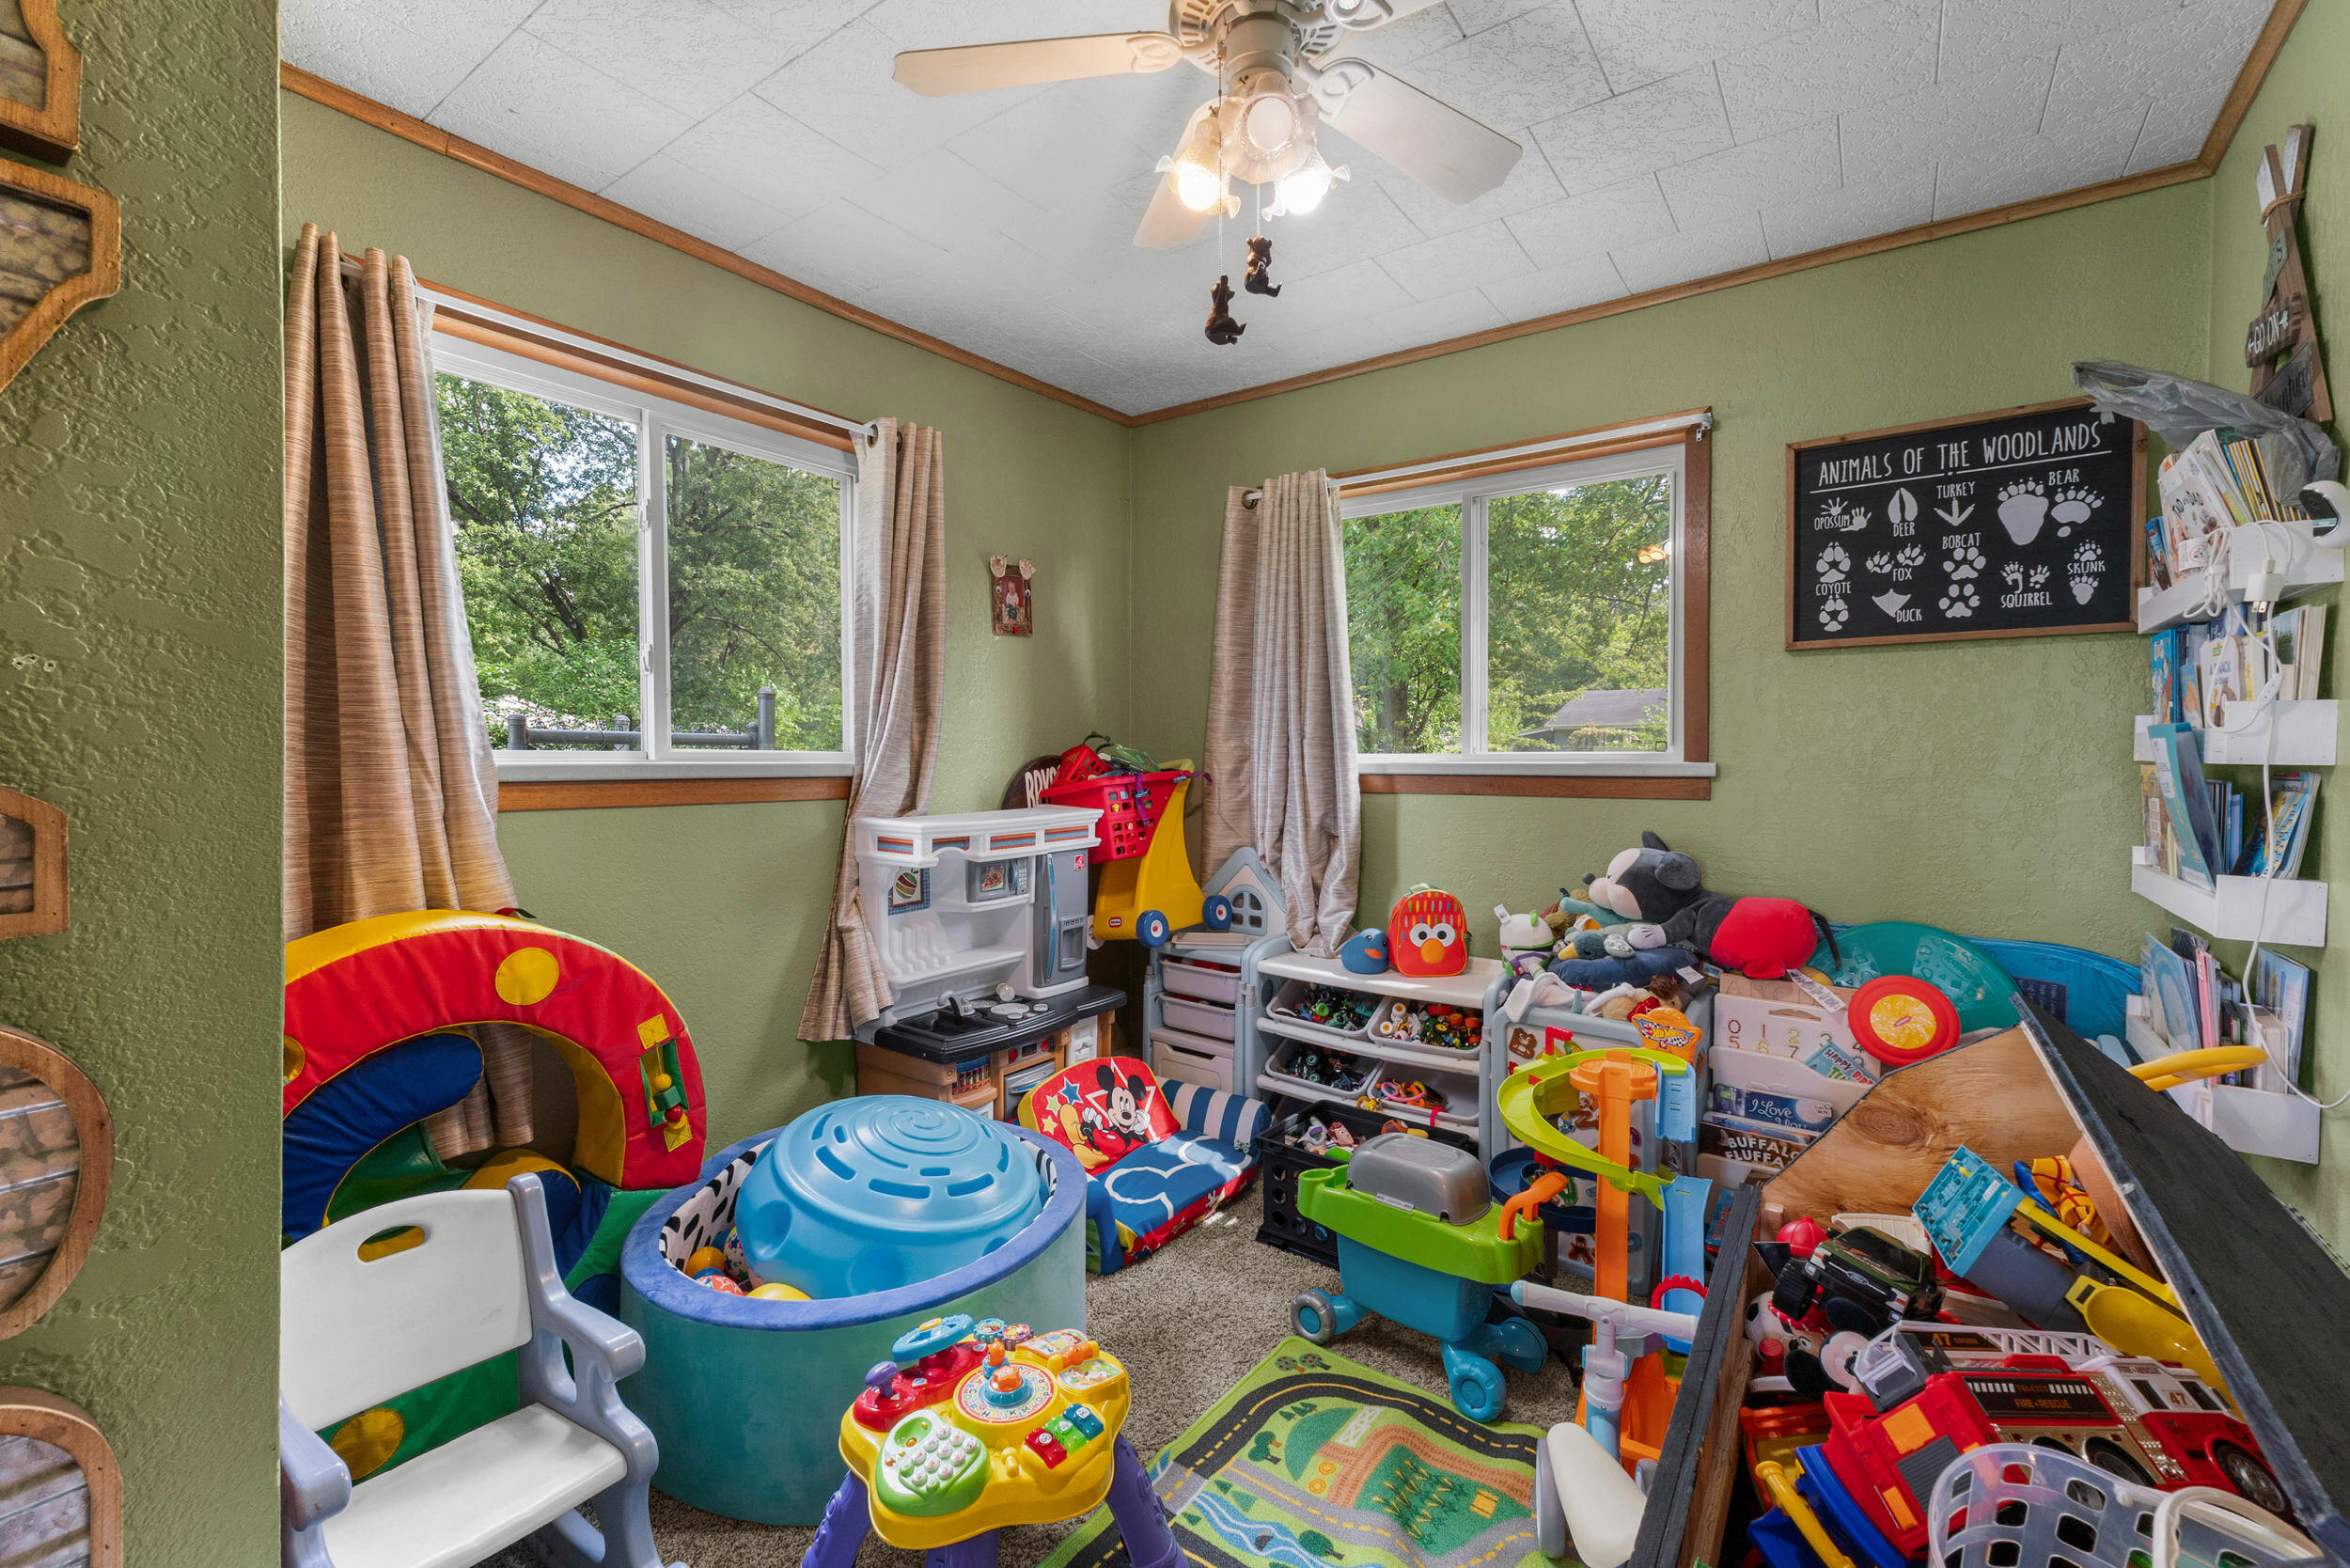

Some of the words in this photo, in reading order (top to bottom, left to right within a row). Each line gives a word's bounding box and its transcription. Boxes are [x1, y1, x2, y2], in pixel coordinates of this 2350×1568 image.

[1818, 452, 1893, 487] ANIMALS
[1903, 447, 1925, 475] OF
[1936, 440, 1971, 470] THE
[1982, 421, 2102, 464] WOODLANDS
[2048, 468, 2080, 486] BEAR
[1936, 481, 1976, 499] TURKEY
[1813, 514, 1851, 531] OPOSSUM
[1892, 522, 1915, 537] DEER
[1942, 532, 1982, 550] BOBCAT
[1892, 567, 1913, 582] FOX
[2066, 560, 2106, 574] SKUNK
[1815, 581, 1852, 596] COYOTE
[2000, 591, 2053, 608] SQUIRREL
[1896, 608, 1922, 622] DUCK
[1788, 1027, 1800, 1044] 2
[1729, 1036, 1740, 1049] 5
[1757, 1040, 1769, 1055] 6
[1788, 1045, 1800, 1058] 7
[1825, 1048, 1853, 1071] HAPPY
[1757, 1100, 1794, 1119] Love
[1728, 1136, 1800, 1160] BUFFALO
[1724, 1149, 1787, 1168] FLUFFA
[2013, 1398, 2033, 1408] FIRE
[2037, 1399, 2072, 1409] RESCUE
[2169, 1391, 2188, 1406] 47
